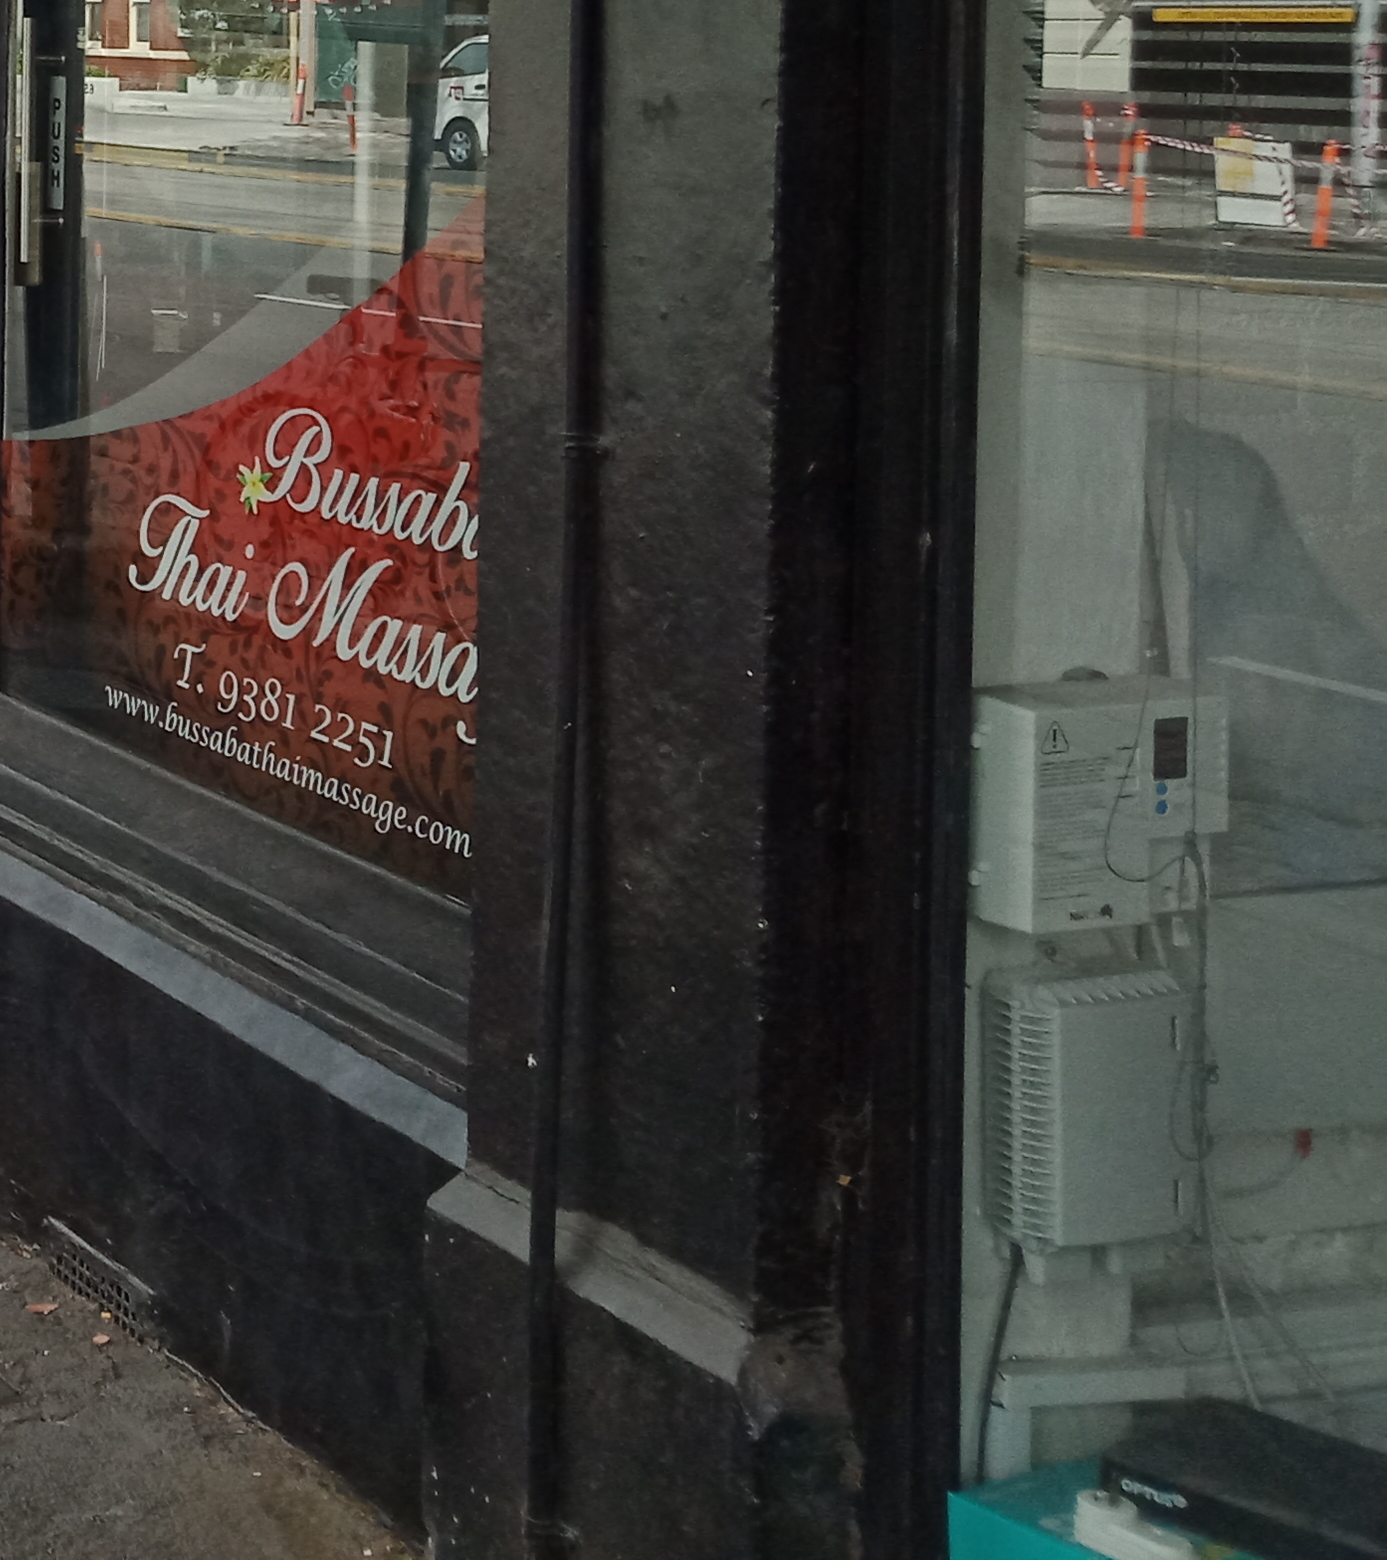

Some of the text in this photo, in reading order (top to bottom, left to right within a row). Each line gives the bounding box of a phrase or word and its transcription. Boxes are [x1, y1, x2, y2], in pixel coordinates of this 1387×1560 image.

[52, 98, 61, 188] PUSH
[128, 493, 479, 744] Thai Massa
[104, 684, 474, 859] www.bussabathaimassage.com
[173, 642, 395, 770] T. 9381 2251
